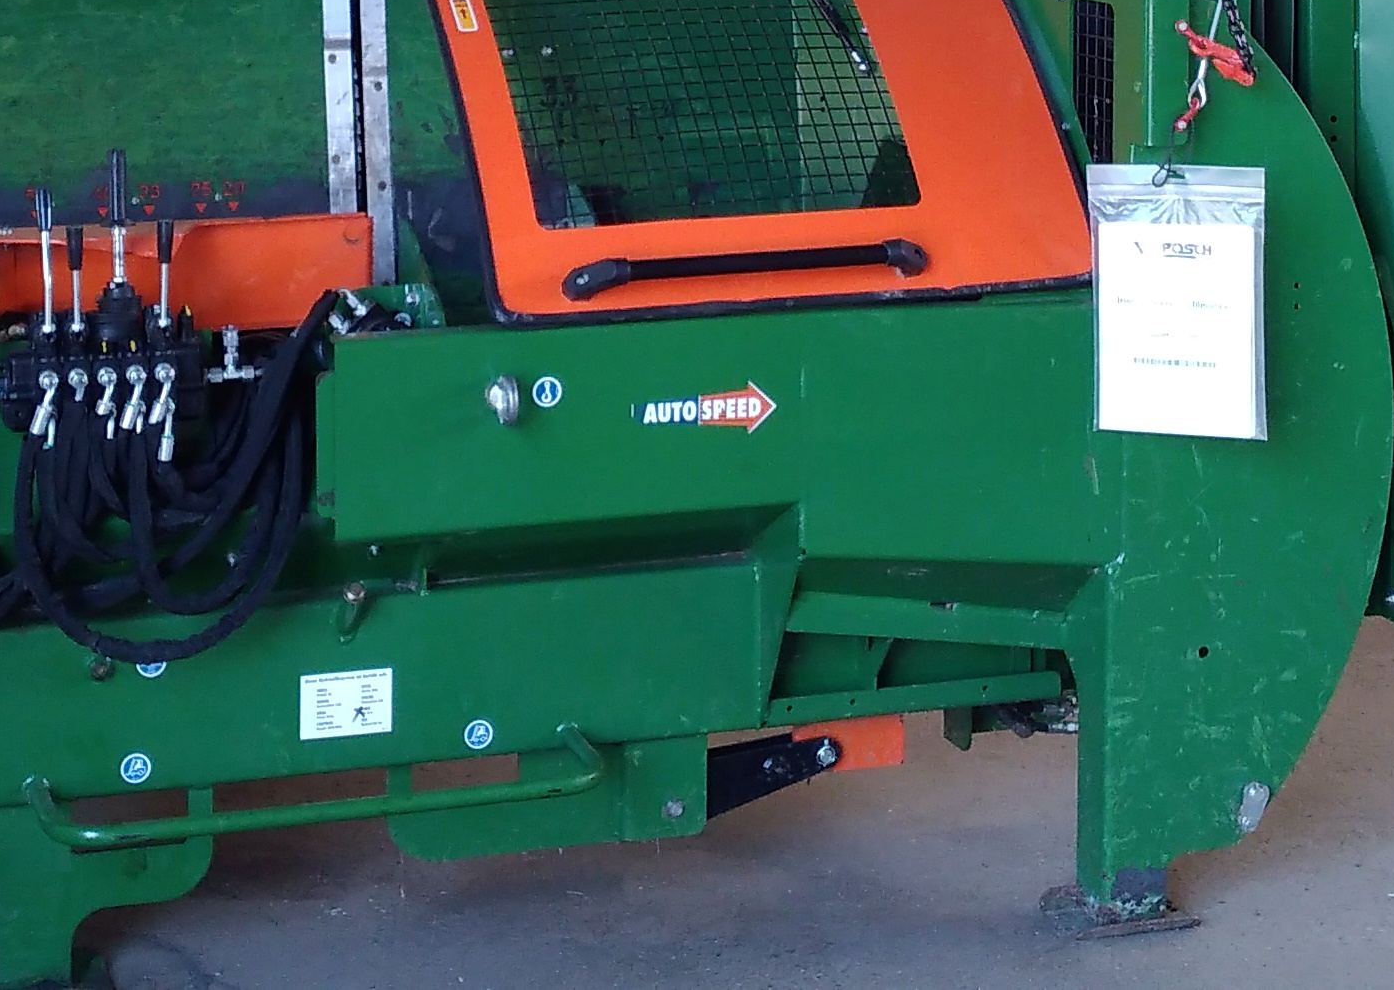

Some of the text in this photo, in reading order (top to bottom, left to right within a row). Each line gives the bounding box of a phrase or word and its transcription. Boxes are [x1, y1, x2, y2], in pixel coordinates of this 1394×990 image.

[1162, 242, 1213, 256] POSCH
[643, 397, 761, 425] AUTO SPEED
